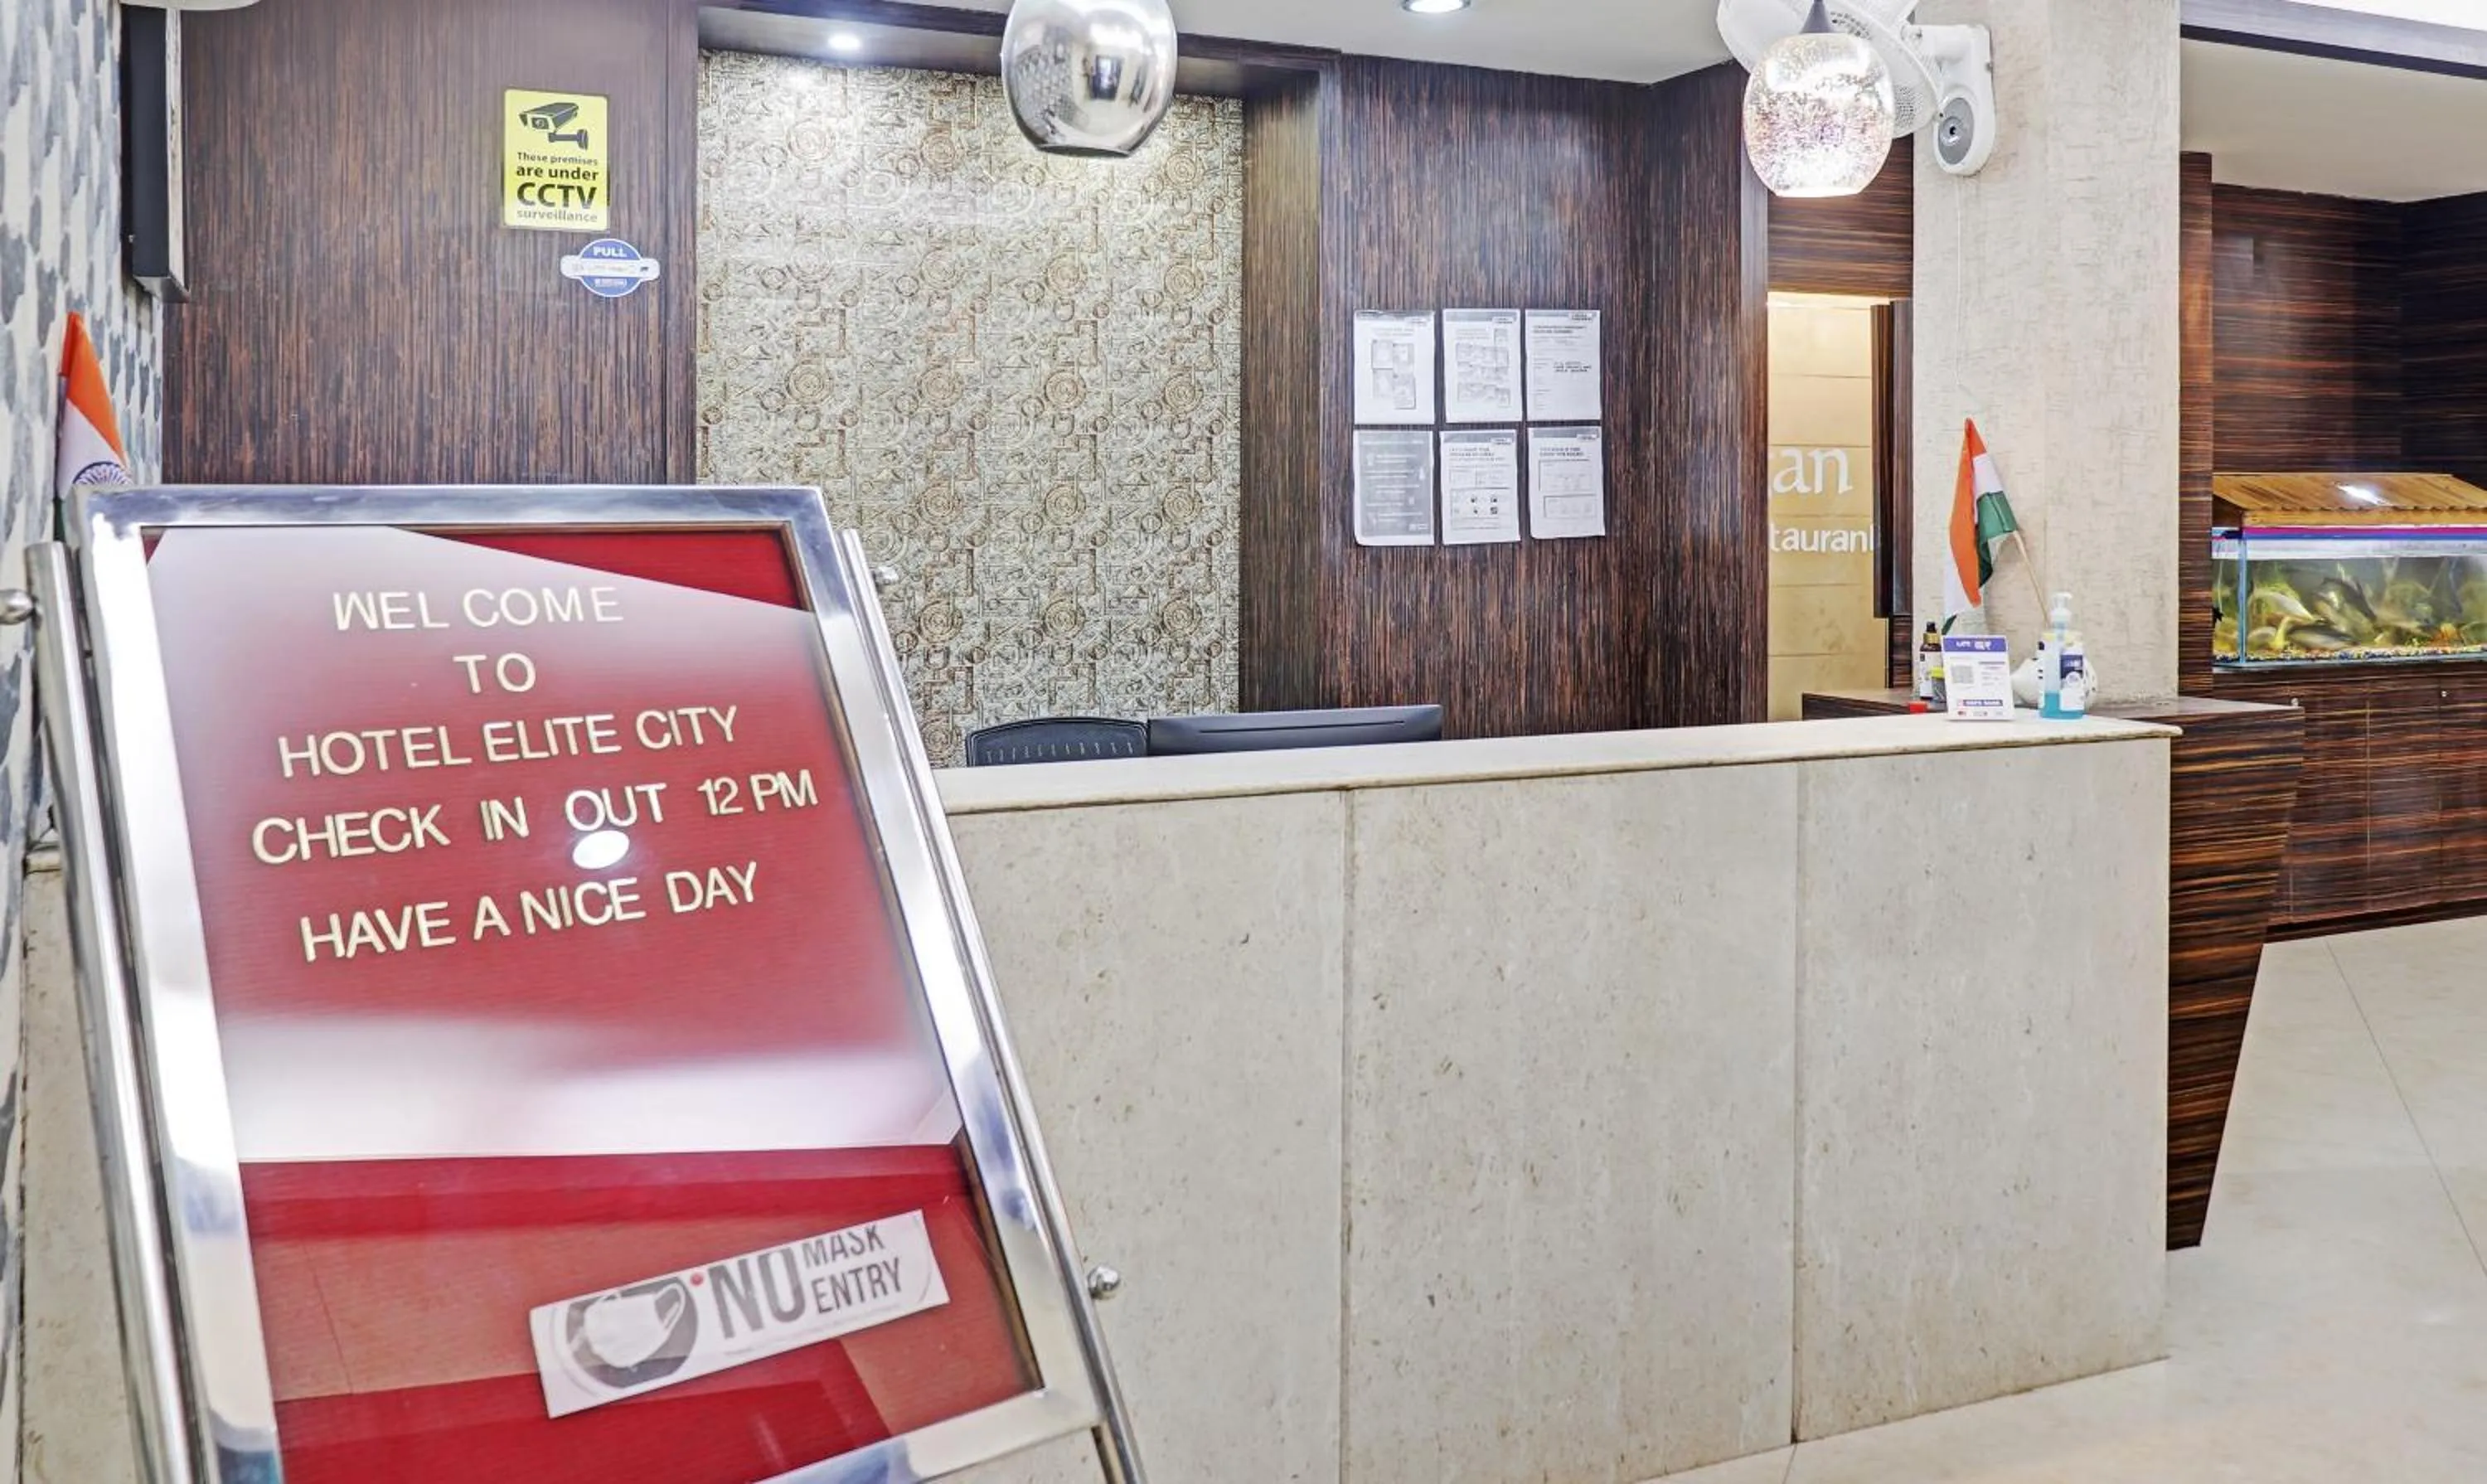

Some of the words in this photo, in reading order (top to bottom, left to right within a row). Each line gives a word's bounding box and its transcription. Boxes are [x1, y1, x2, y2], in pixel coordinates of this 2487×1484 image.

[516, 152, 548, 162] These
[550, 155, 598, 166] premises
[516, 166, 544, 178] are
[548, 167, 599, 182] under
[516, 182, 598, 210] CCTV
[516, 211, 598, 223] surveillance
[593, 246, 628, 258] PULL
[1768, 447, 1854, 496] an
[453, 652, 537, 694] TO
[278, 726, 473, 778] HOTEL
[482, 714, 622, 762] ELITE
[636, 705, 738, 749] CITY
[251, 804, 451, 864] CHECK
[479, 796, 530, 841] IN
[565, 783, 667, 832] OUT
[697, 777, 744, 817] 12
[749, 769, 819, 812] PM
[300, 901, 456, 963] HAVE
[473, 895, 511, 940] A
[520, 876, 647, 934] NICE
[666, 861, 759, 914] DAY
[801, 1224, 885, 1269] MASK
[811, 1257, 902, 1315] ENTRY
